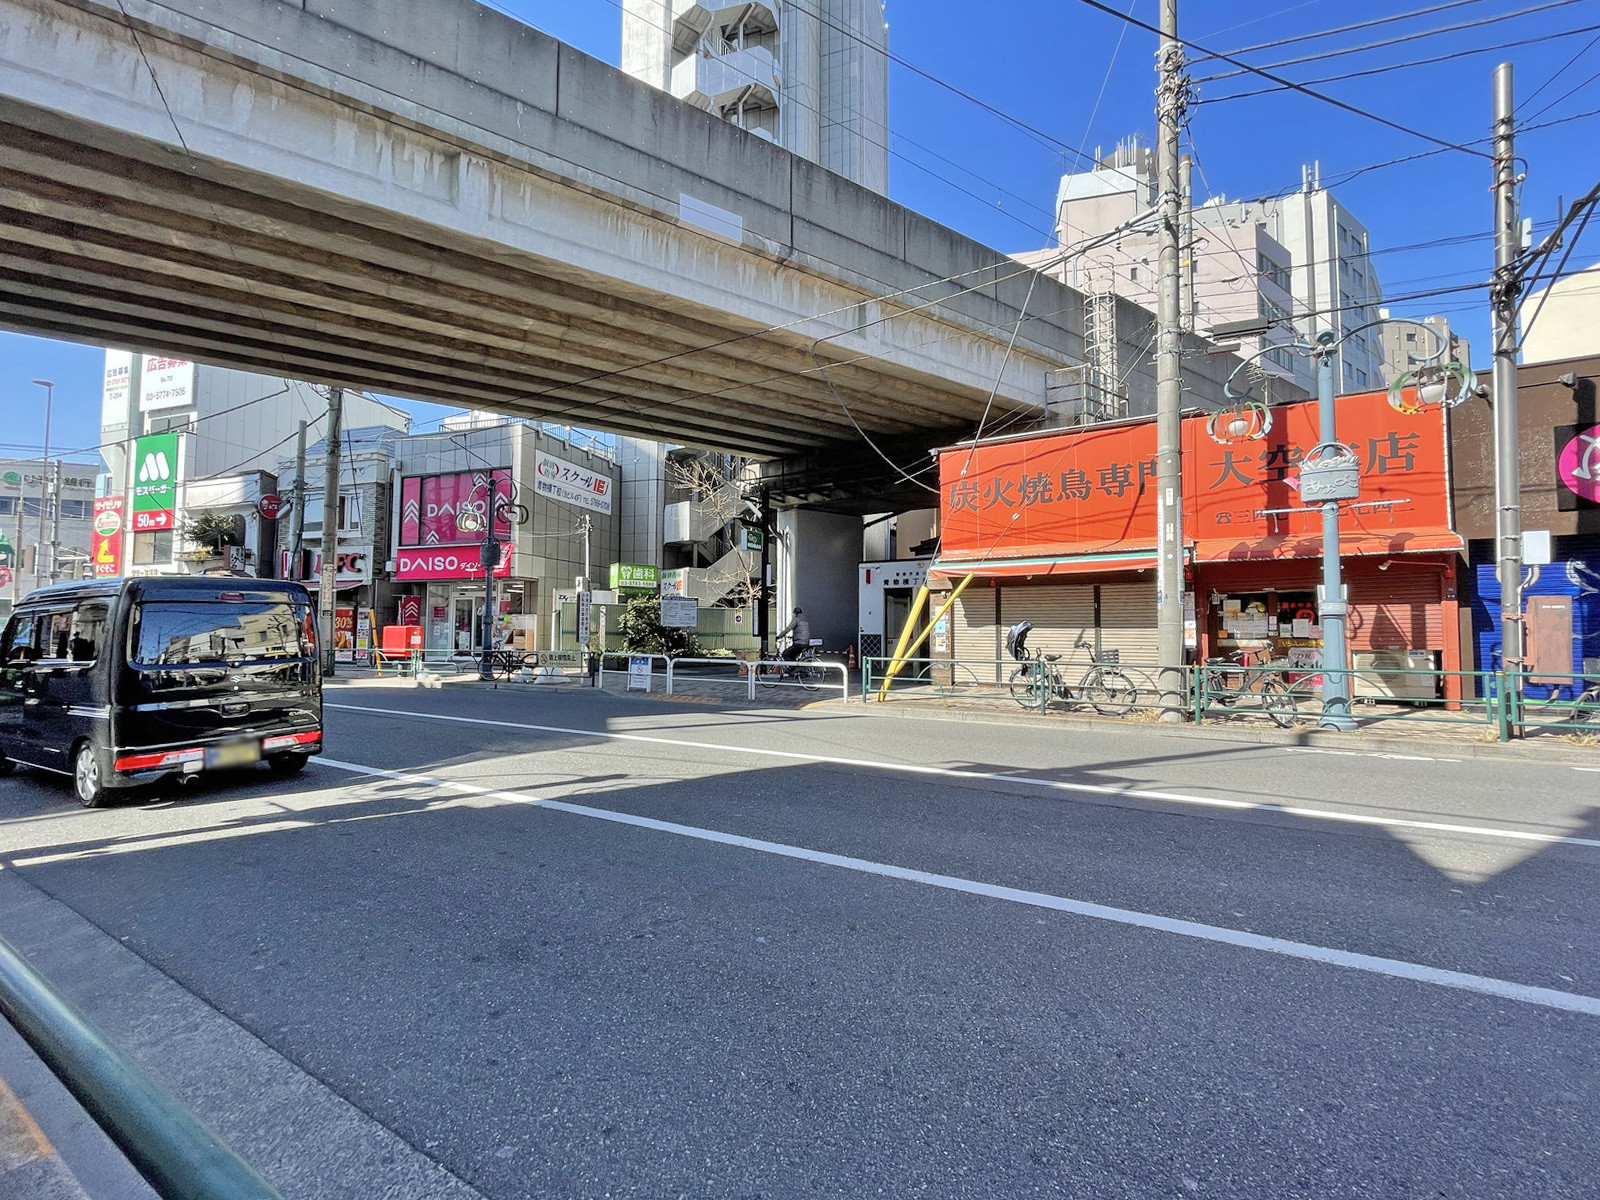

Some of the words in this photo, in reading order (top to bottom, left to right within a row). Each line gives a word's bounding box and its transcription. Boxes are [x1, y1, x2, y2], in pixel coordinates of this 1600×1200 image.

[1209, 431, 1421, 490] 大空店
[136, 484, 172, 496] モスバーガー
[137, 513, 155, 527] 50m
[400, 556, 458, 572] DAISO
[632, 567, 655, 580] 歯科
